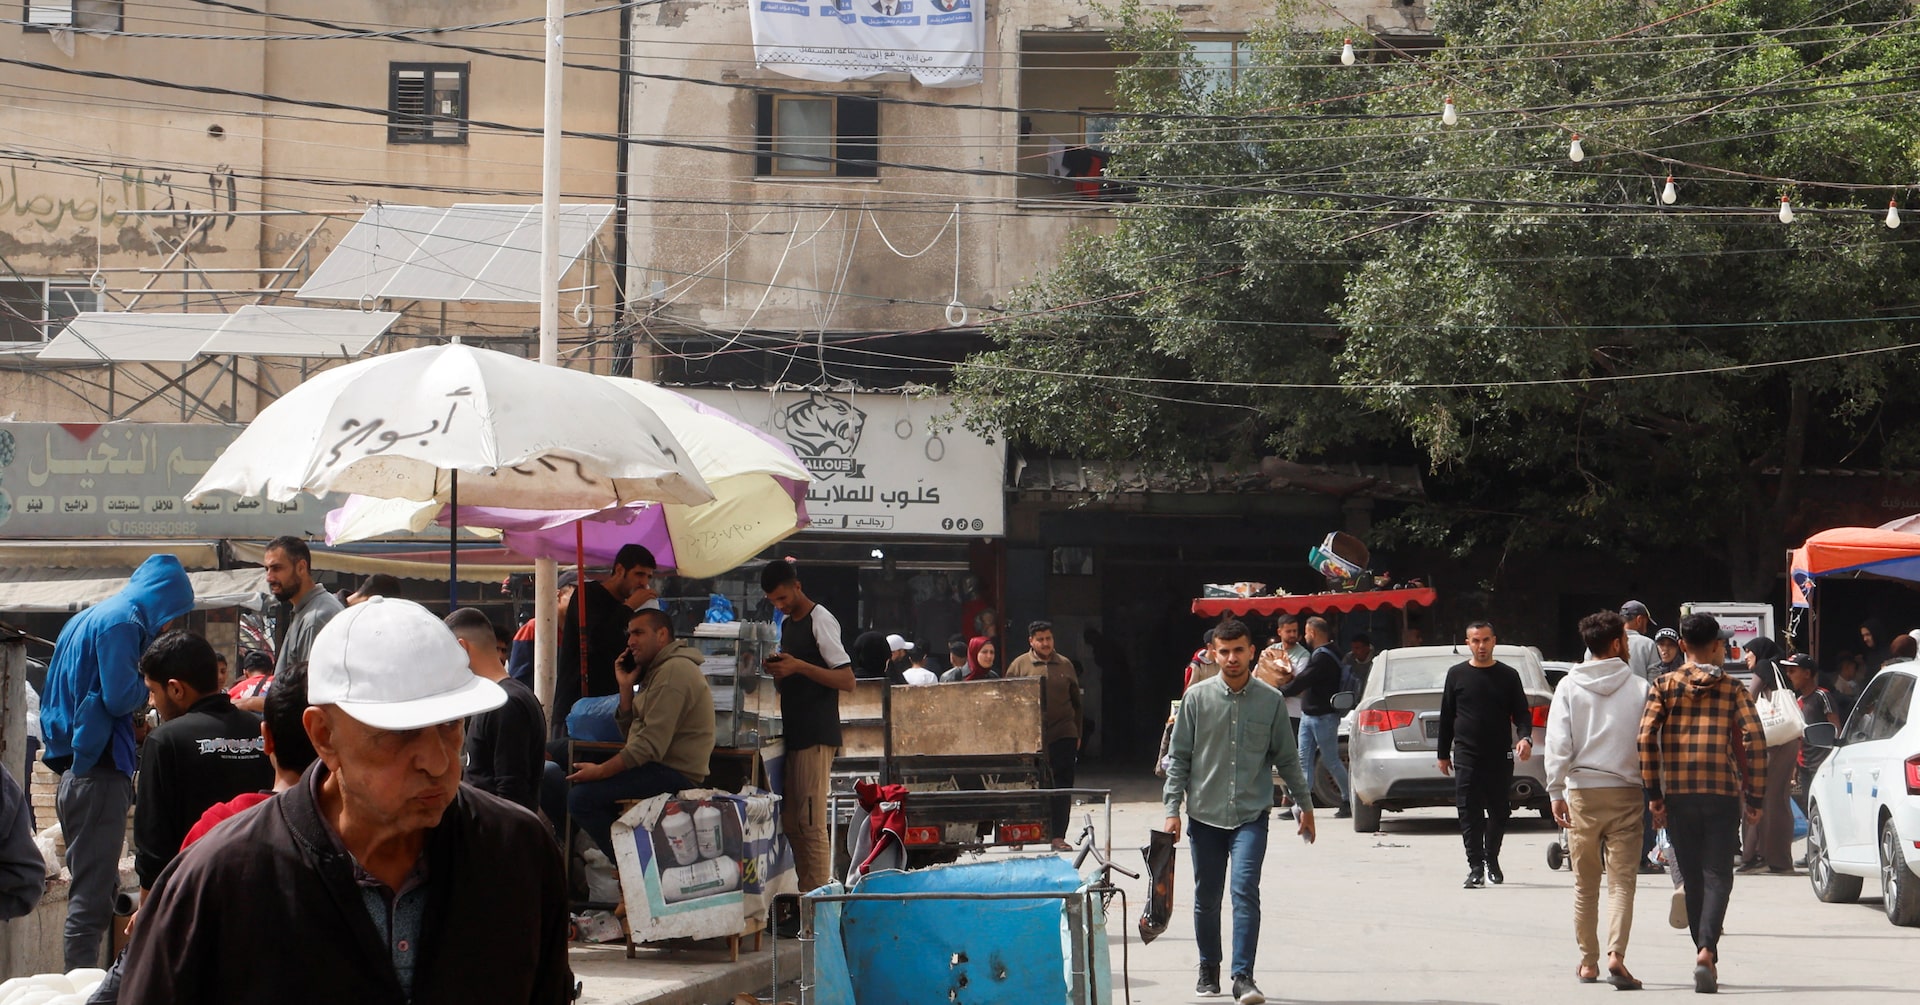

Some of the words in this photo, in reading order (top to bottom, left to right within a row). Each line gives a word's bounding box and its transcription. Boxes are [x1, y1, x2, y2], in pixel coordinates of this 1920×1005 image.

[27, 428, 157, 488] النخيل
[152, 500, 173, 512] فلافل
[855, 517, 885, 528] رجالي
